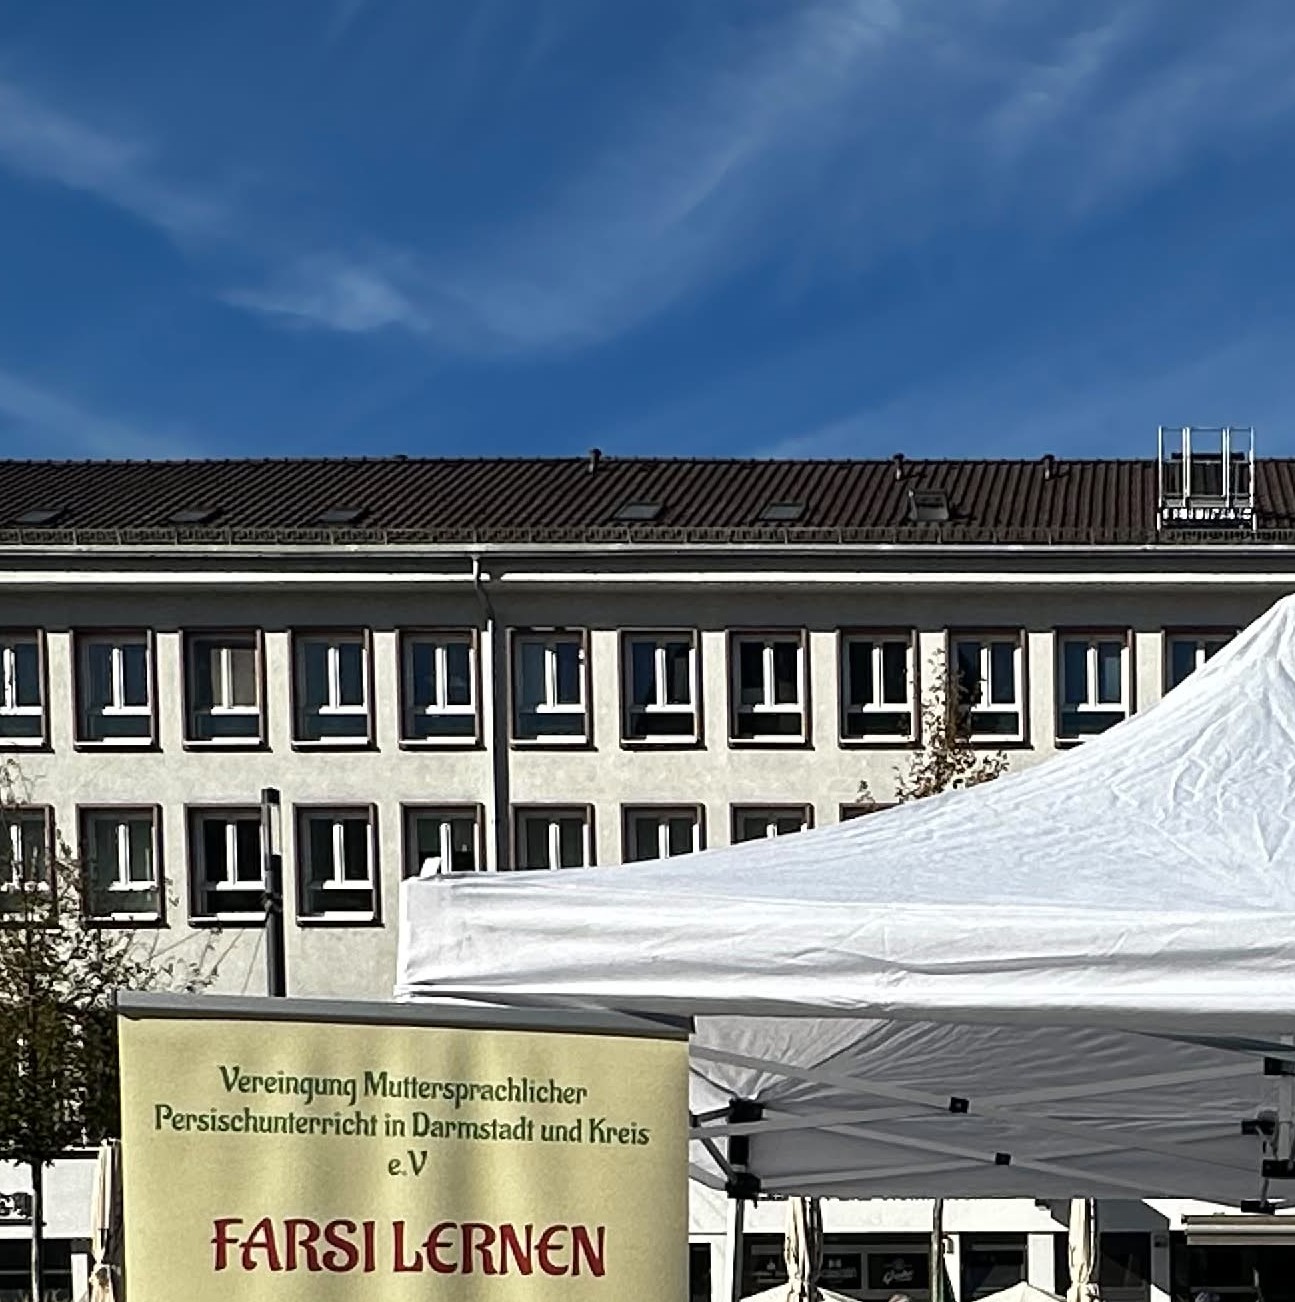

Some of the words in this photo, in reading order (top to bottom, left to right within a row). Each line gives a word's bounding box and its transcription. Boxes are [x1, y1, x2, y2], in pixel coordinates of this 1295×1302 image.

[218, 1065, 357, 1107] Vereingung
[363, 1070, 588, 1110] Muttersprachlicher
[155, 1104, 378, 1136] Persischunterricht
[384, 1113, 406, 1137] in
[413, 1112, 534, 1142] Darmstadt
[541, 1118, 582, 1143] und
[589, 1118, 650, 1145] Kreis
[388, 1150, 428, 1176] e.V
[211, 1216, 376, 1272] FARSI
[392, 1220, 606, 1277] LERNEN
